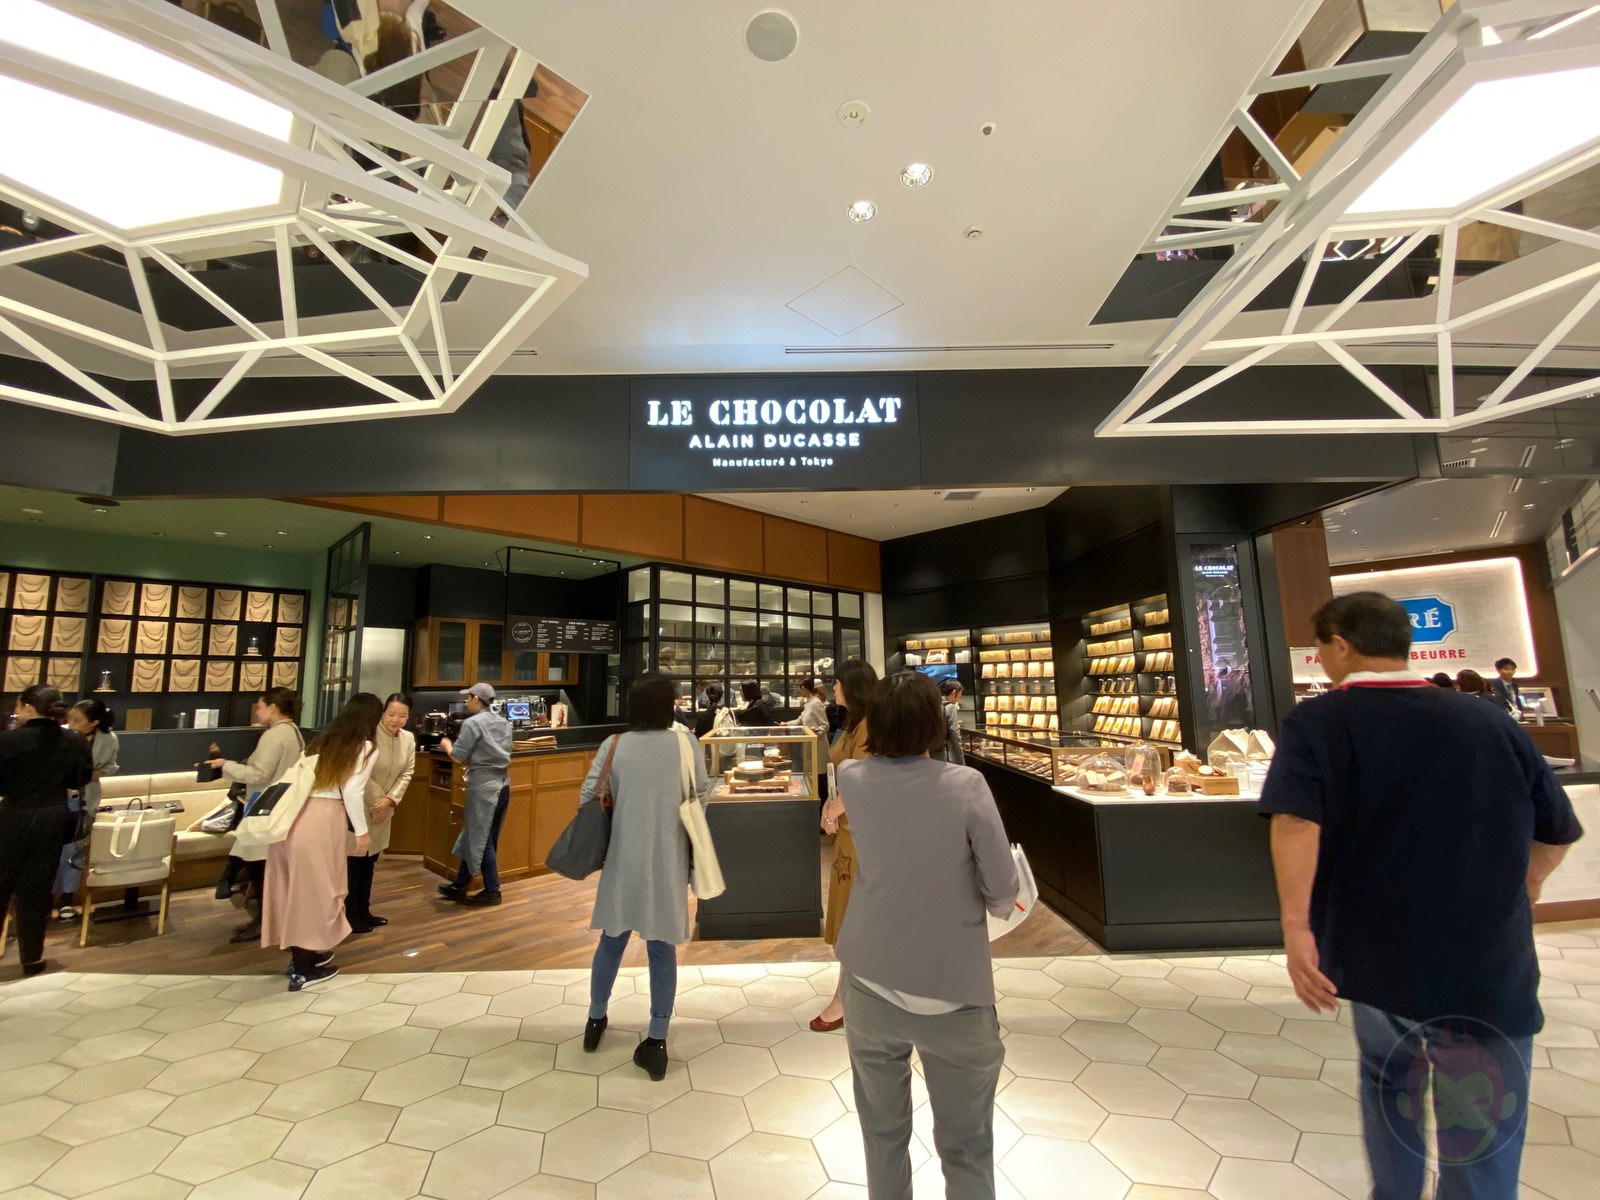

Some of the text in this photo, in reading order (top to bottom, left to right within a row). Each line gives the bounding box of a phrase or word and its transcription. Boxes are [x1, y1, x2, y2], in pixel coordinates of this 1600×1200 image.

[648, 398, 902, 425] LE CHOCOLAT
[689, 433, 861, 449] ALAIN DUCASSE
[801, 456, 834, 468] Tokyo
[1410, 648, 1467, 661] BEURRE
